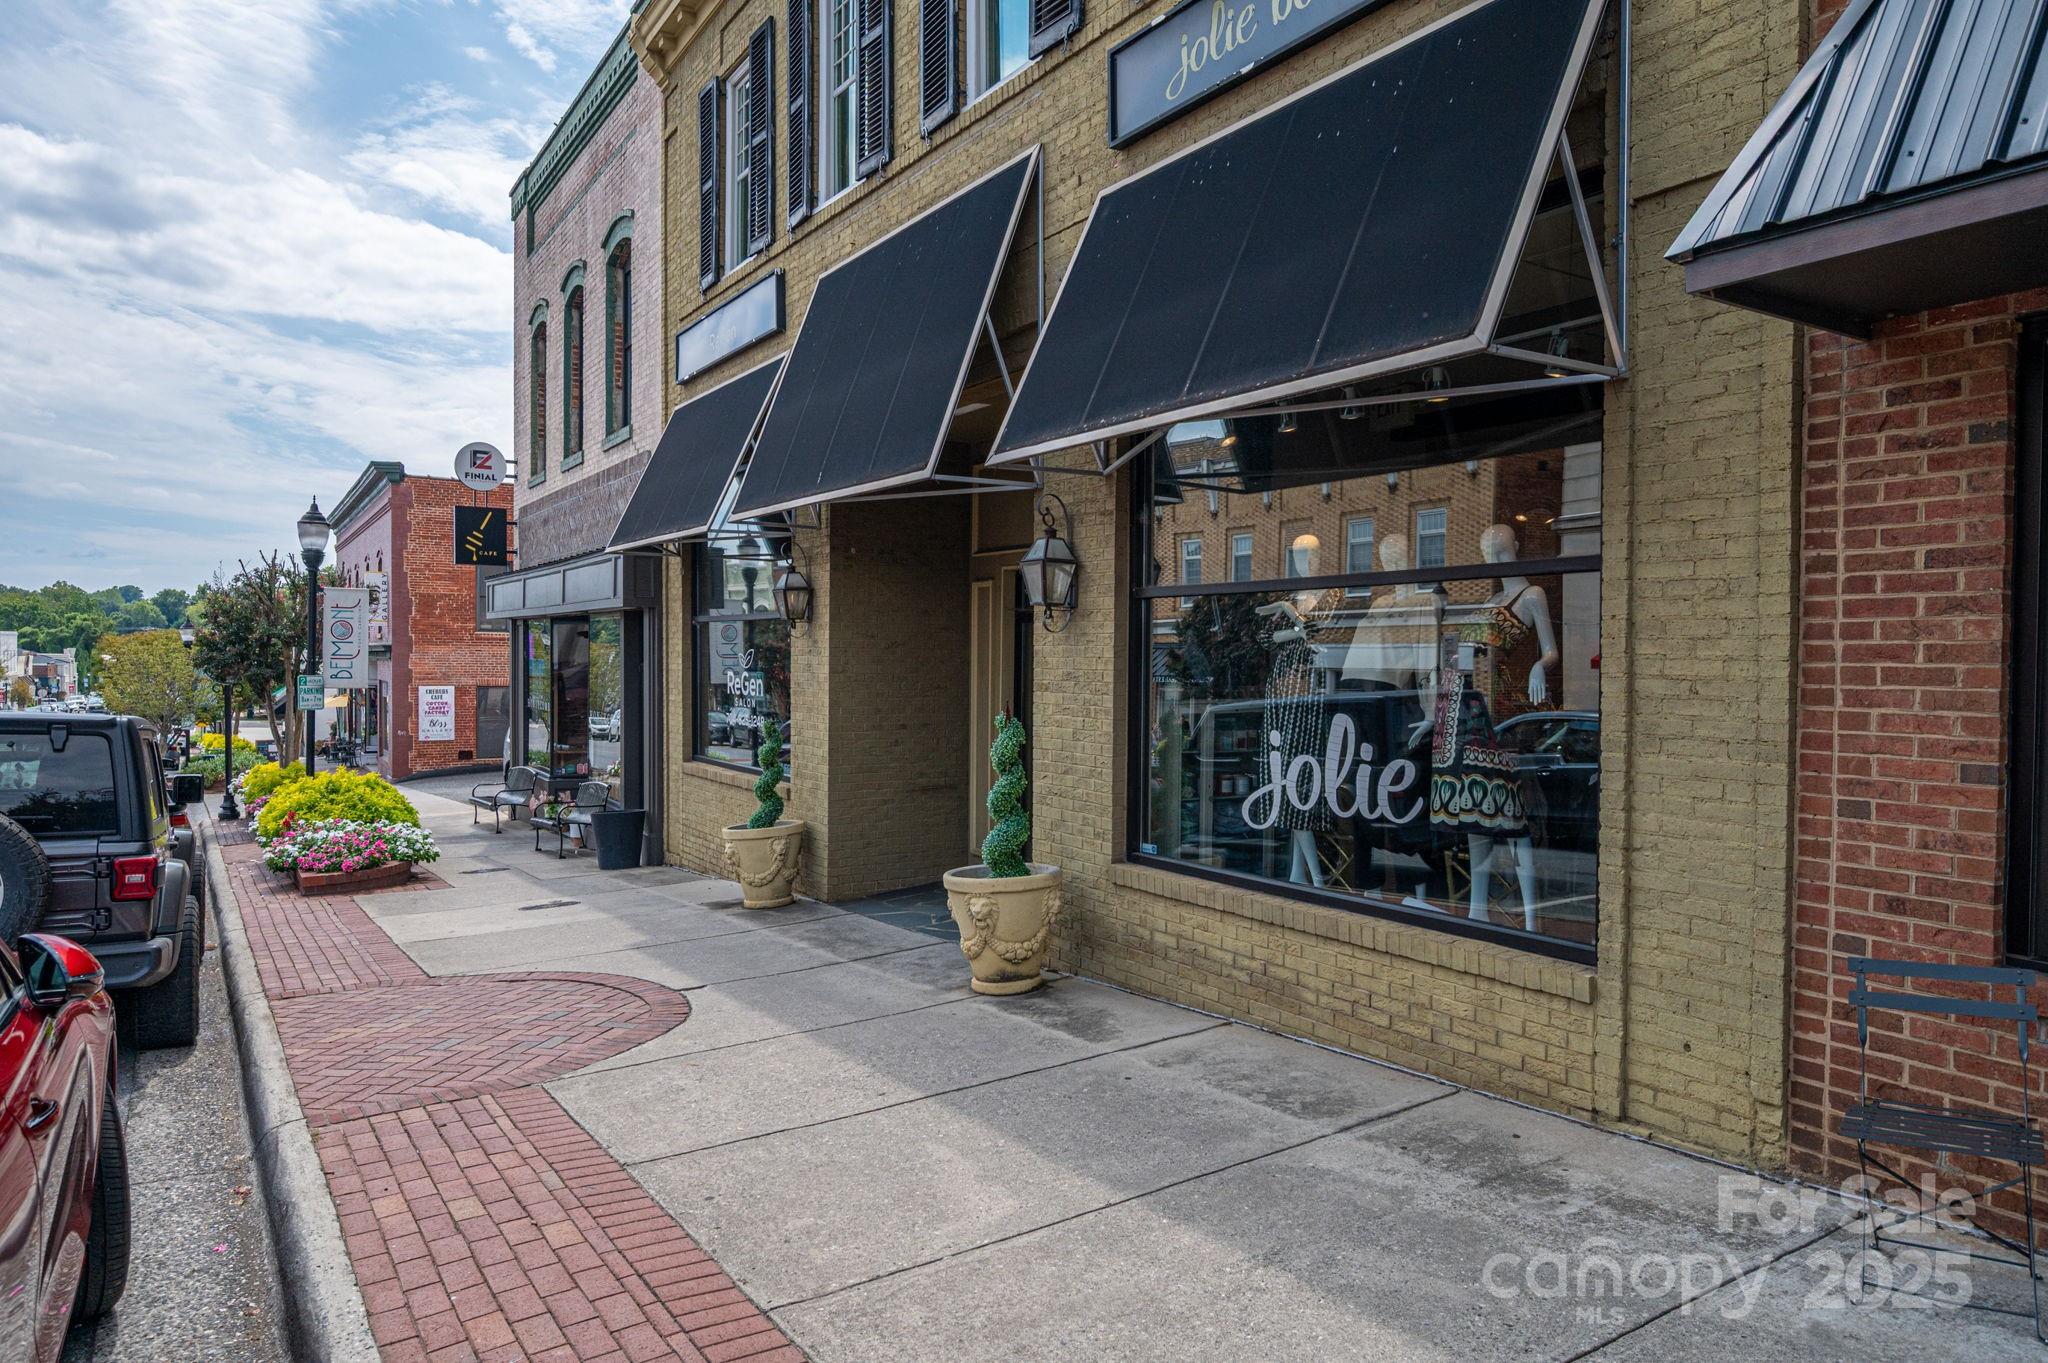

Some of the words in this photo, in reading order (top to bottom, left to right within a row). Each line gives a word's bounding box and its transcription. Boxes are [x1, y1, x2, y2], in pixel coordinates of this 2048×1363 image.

[1166, 1, 1258, 100] jolie
[464, 471, 497, 481] FINIAL
[300, 677, 306, 685] 2
[727, 671, 764, 697] ReGen
[300, 687, 323, 695] PARKING
[735, 698, 756, 708] SALON
[1241, 713, 1424, 830] jolie
